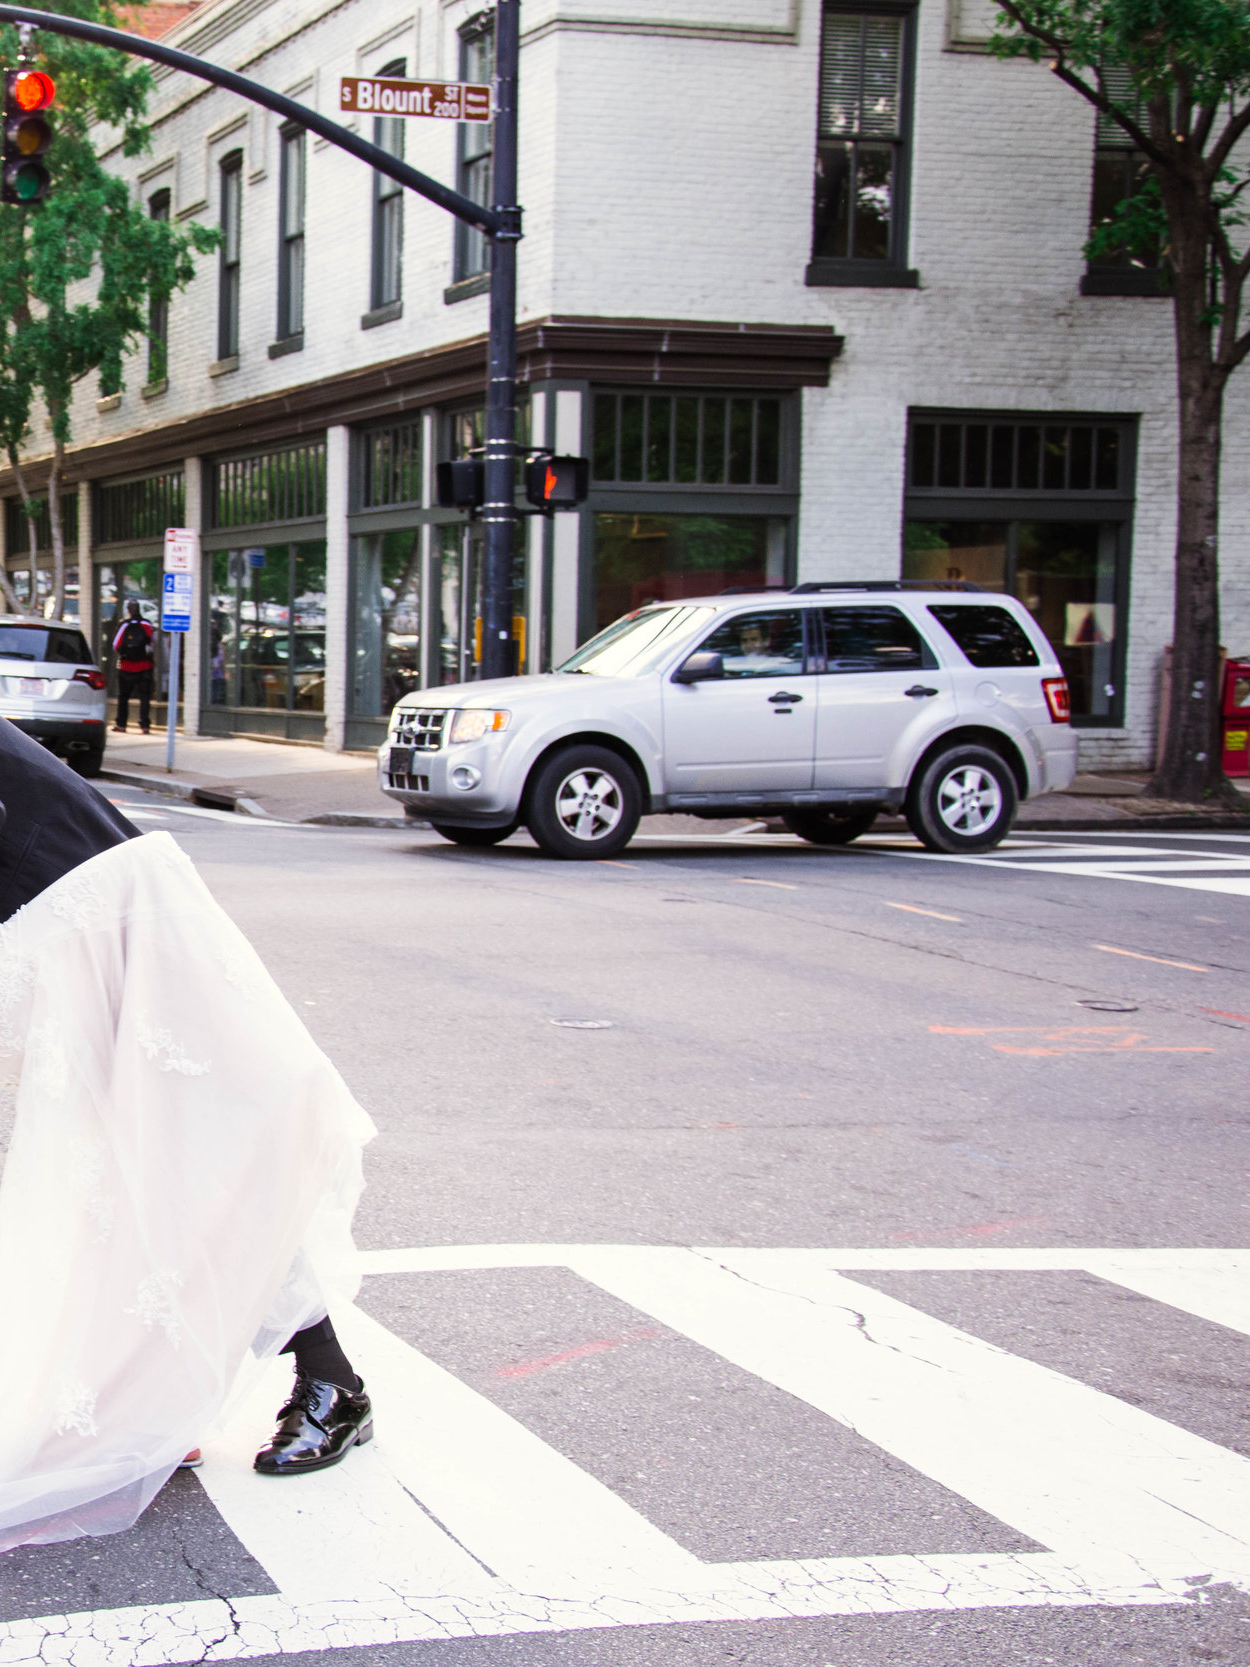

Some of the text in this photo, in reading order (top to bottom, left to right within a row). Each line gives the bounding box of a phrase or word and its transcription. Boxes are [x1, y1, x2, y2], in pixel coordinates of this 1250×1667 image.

[357, 81, 432, 114] Blount
[444, 86, 459, 101] ST
[433, 101, 459, 118] 200
[166, 577, 174, 591] 2
